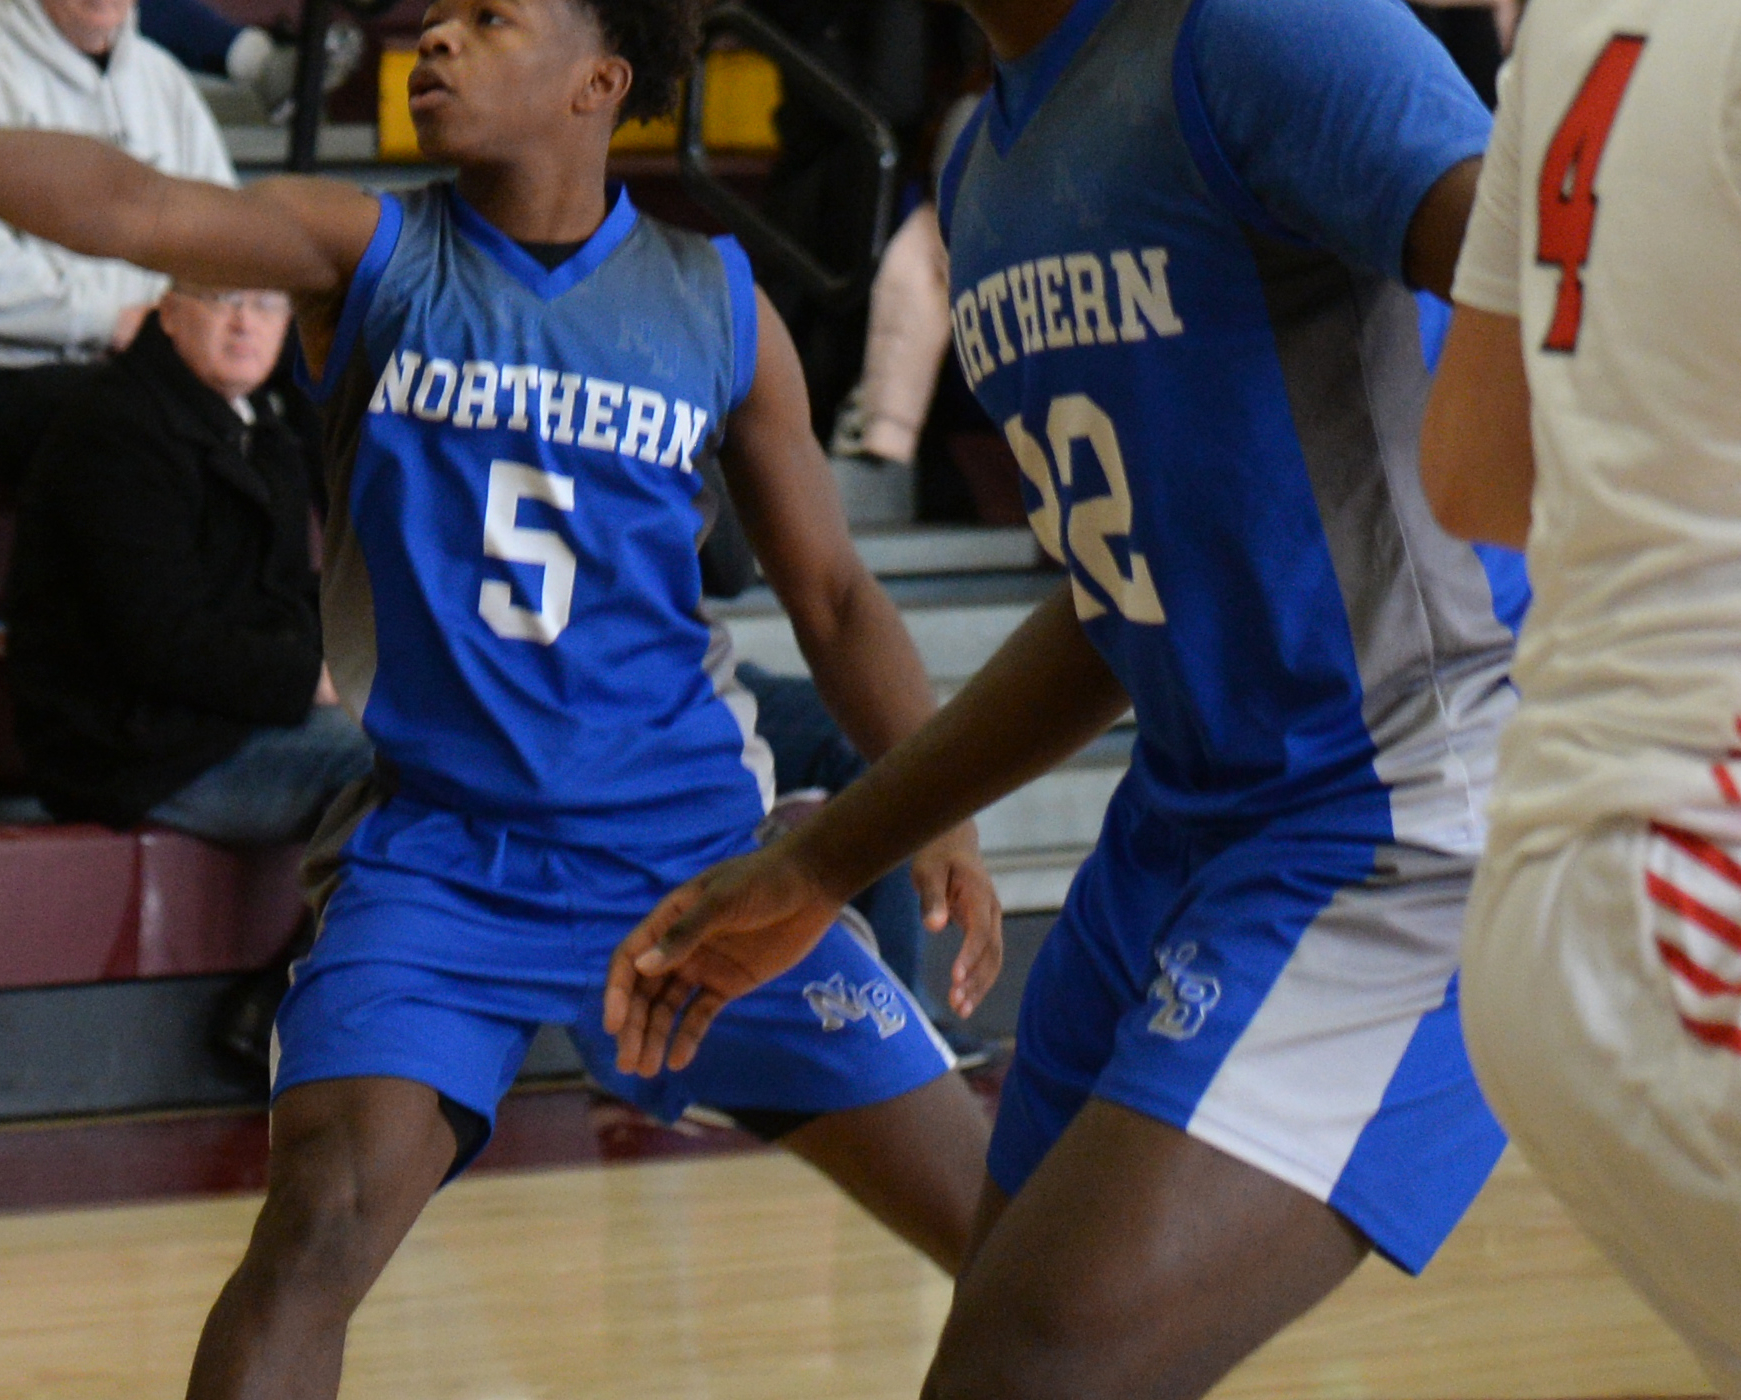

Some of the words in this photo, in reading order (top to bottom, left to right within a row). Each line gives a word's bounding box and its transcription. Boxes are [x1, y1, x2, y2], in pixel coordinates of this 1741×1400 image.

[1535, 32, 1648, 352] 4
[368, 349, 707, 474] NORTHERN
[1004, 394, 1166, 625] 22
[478, 459, 576, 646] 5
